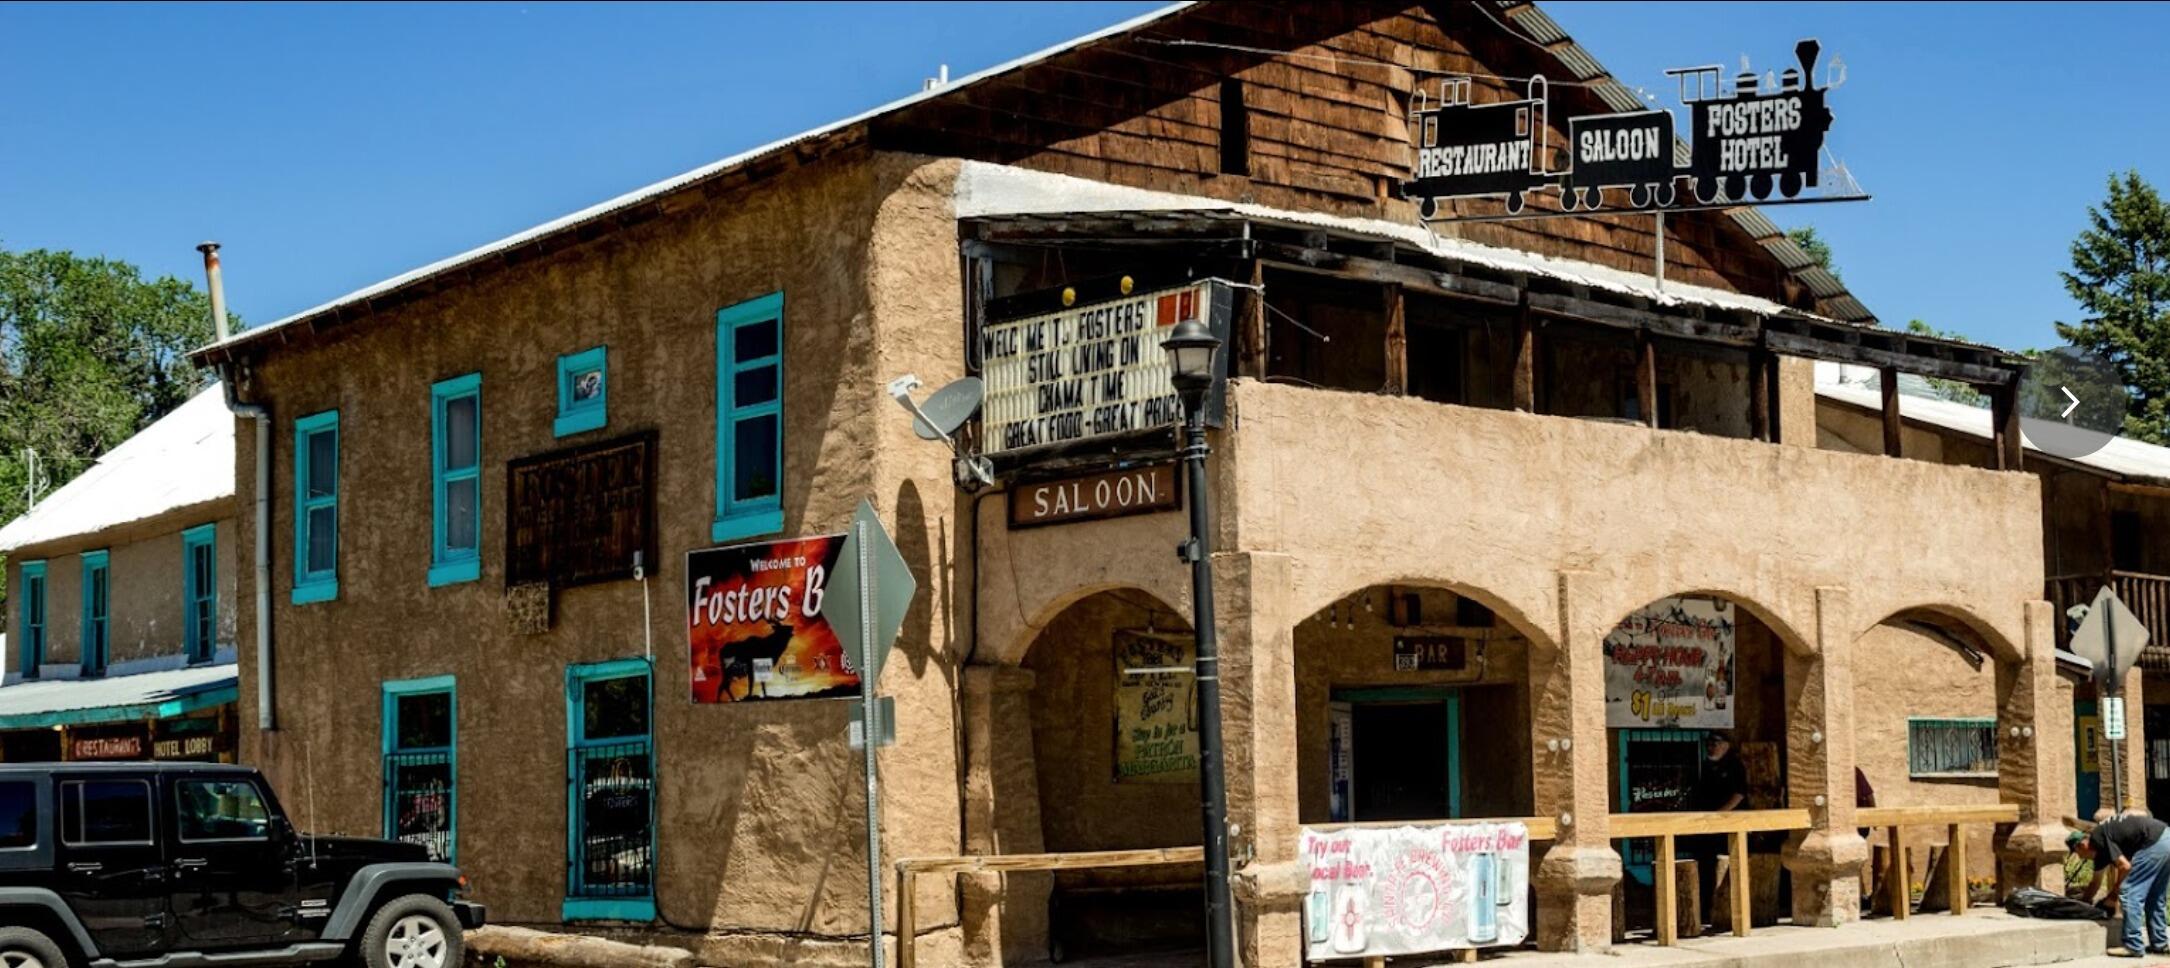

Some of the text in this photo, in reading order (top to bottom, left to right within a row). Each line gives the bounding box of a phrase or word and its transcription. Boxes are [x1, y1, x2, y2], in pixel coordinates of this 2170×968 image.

[1707, 97, 1802, 138] FOSTERS
[1418, 139, 1530, 178] RESTAURANT
[1580, 127, 1660, 163] SALOON
[1720, 135, 1788, 172] HOTEL
[1079, 301, 1145, 341] FOSTERS
[1028, 338, 1140, 384] STILL LIVING ON
[1038, 378, 1083, 414] CHAMA
[1006, 417, 1045, 449] GREAT
[1049, 411, 1083, 441] FOOD
[1094, 401, 1138, 435] GREAT
[1034, 472, 1156, 517] SALOON
[693, 575, 792, 626] Fosters
[1414, 644, 1448, 664] BAR
[1631, 690, 1651, 722] $1
[154, 737, 214, 756] HOTEL LOBBY
[1308, 836, 1329, 859] Try
[1441, 831, 1492, 853] Fosters
